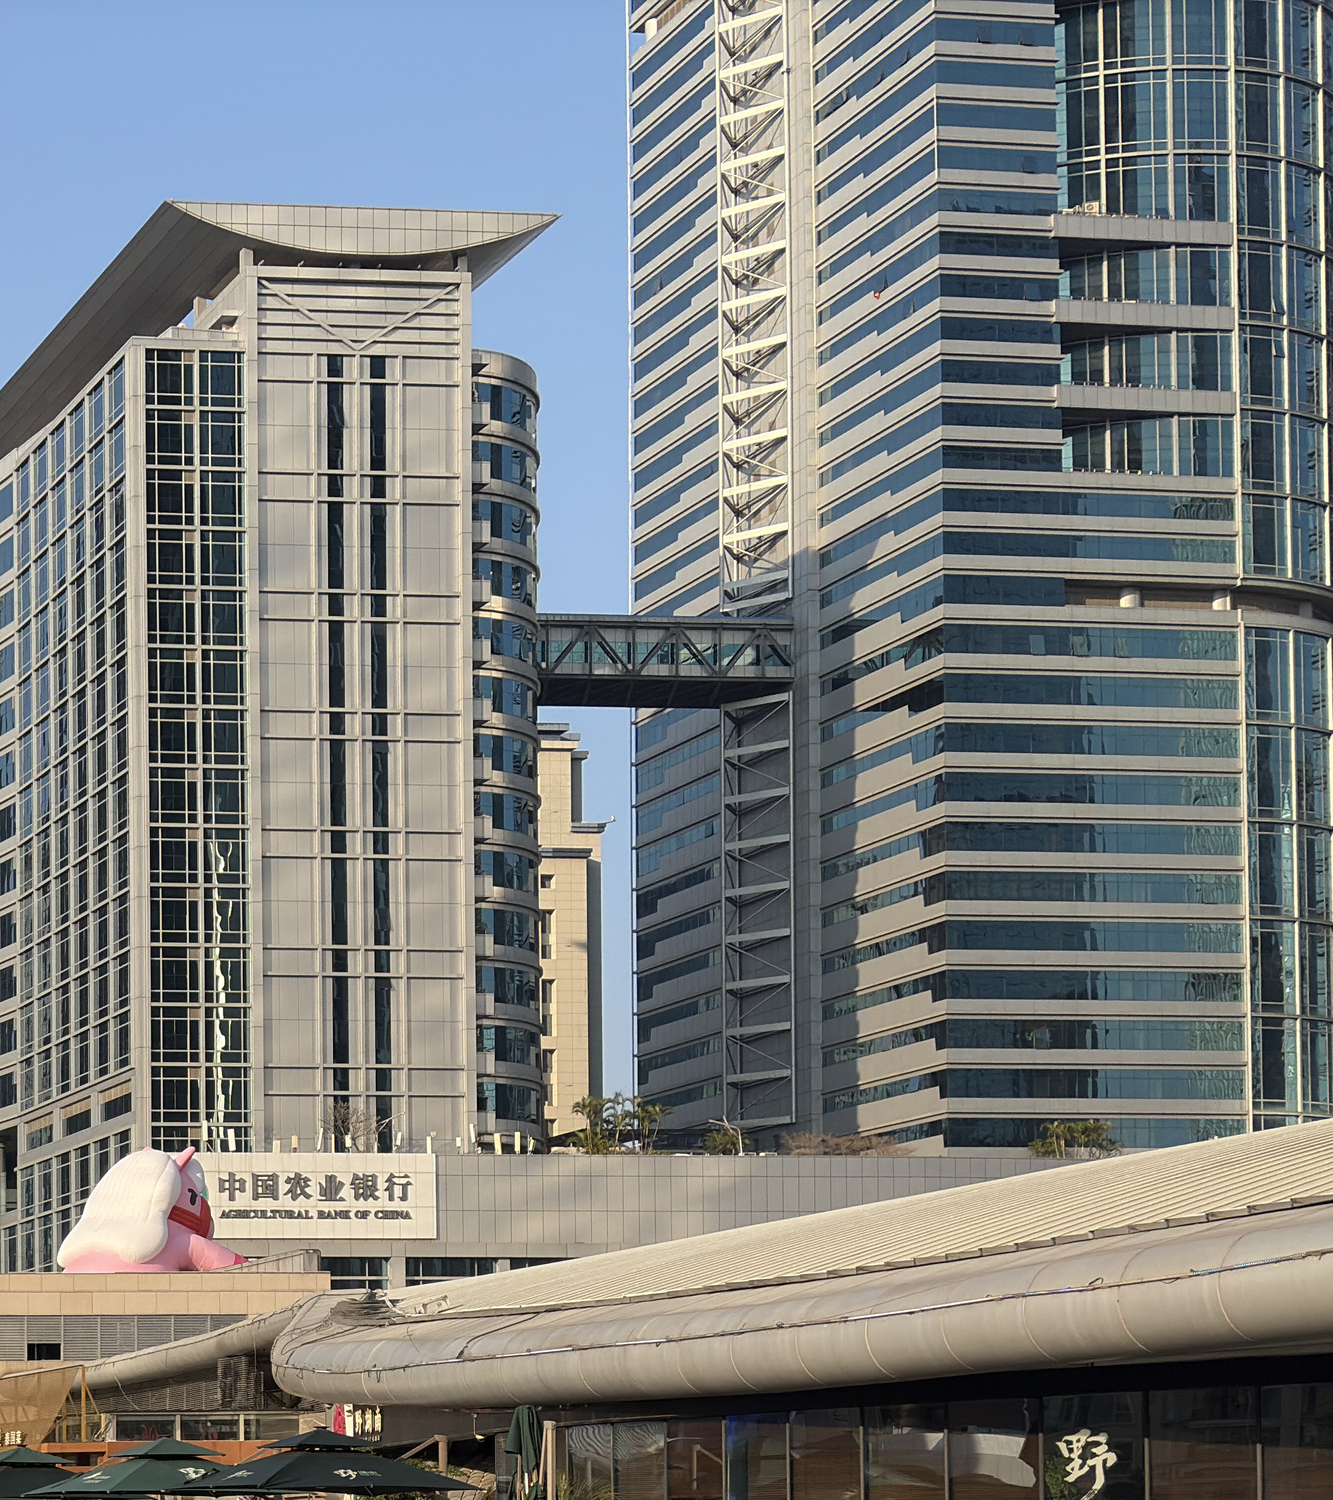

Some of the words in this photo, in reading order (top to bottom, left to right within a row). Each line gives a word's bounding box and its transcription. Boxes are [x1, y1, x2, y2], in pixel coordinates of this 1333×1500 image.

[218, 1171, 414, 1202] 中国农业银行
[219, 1208, 315, 1220] AGRICULTURAL
[317, 1209, 352, 1220] BANK
[354, 1209, 371, 1220] OF
[373, 1209, 413, 1220] CHINA
